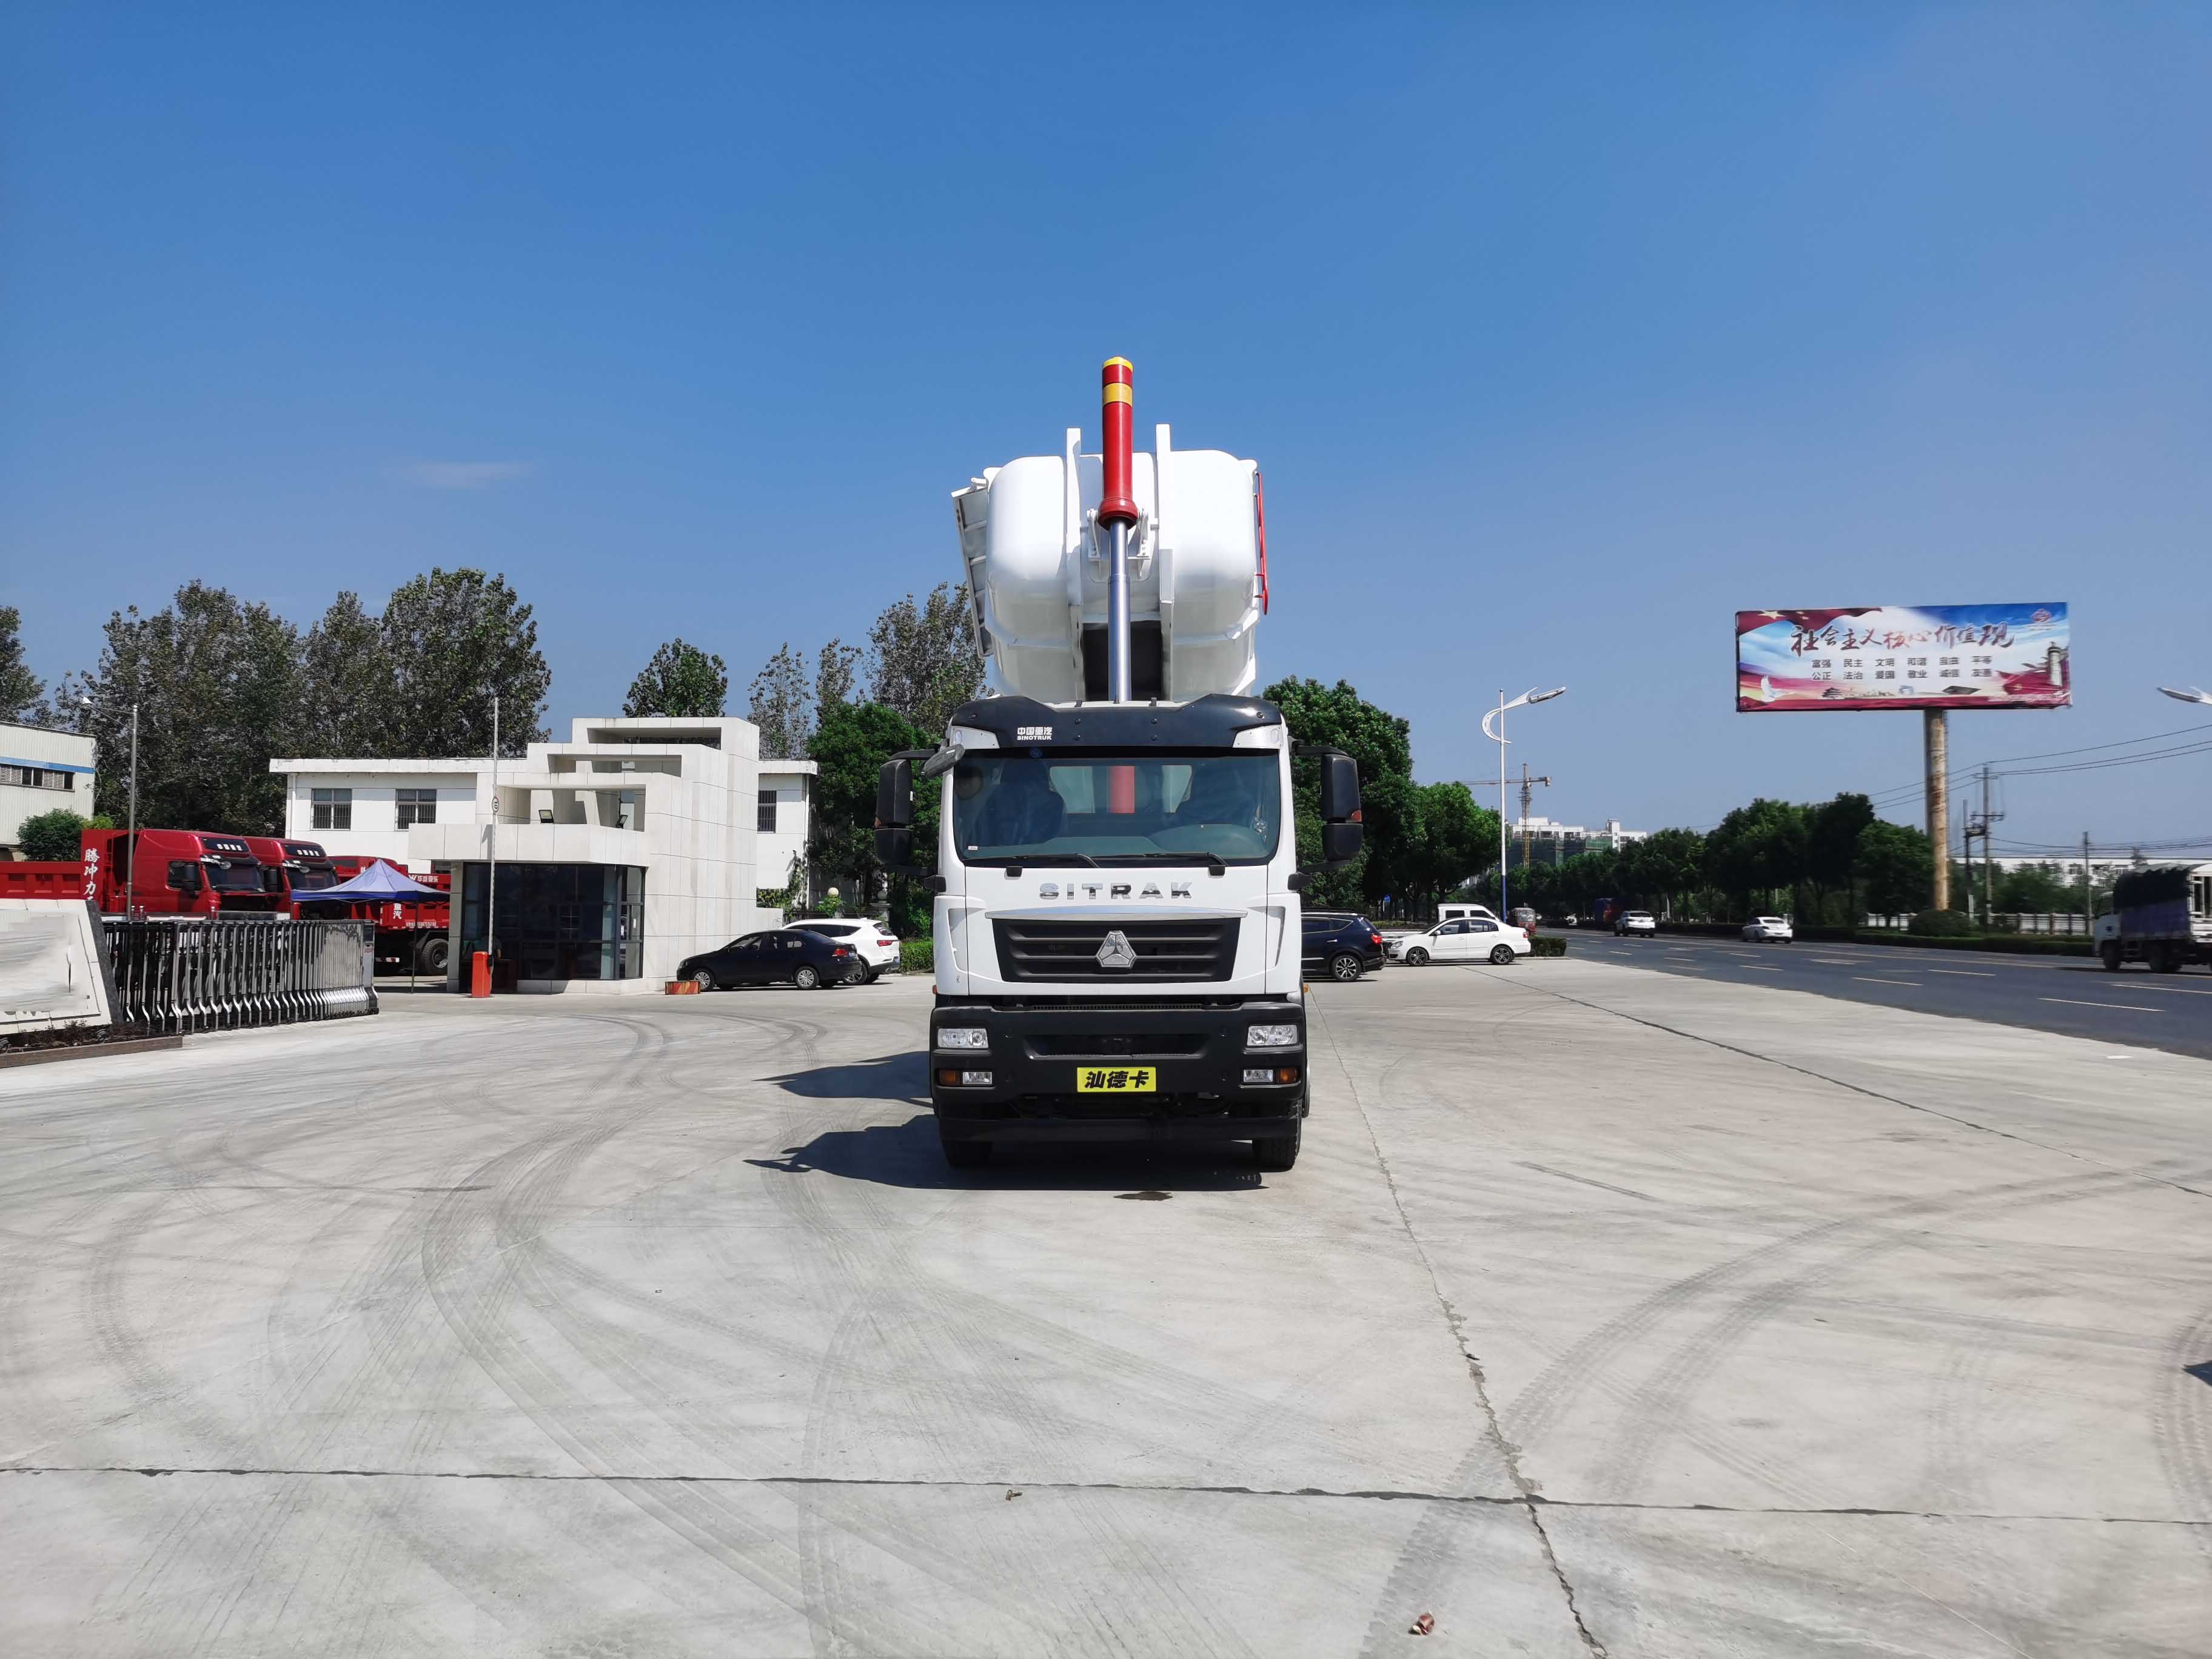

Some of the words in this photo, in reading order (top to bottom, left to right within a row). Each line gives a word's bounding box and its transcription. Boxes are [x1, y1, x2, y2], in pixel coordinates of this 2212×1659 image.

[1791, 622, 2015, 657] 社会主义核心价值观
[1843, 659, 1863, 667] 民主
[1811, 671, 1831, 680] 公正
[1017, 726, 1053, 736] 中国重汽
[84, 848, 100, 900] 腾冲力
[1039, 882, 1194, 900] SITRAK
[1084, 1070, 1150, 1088] 汕德卡
